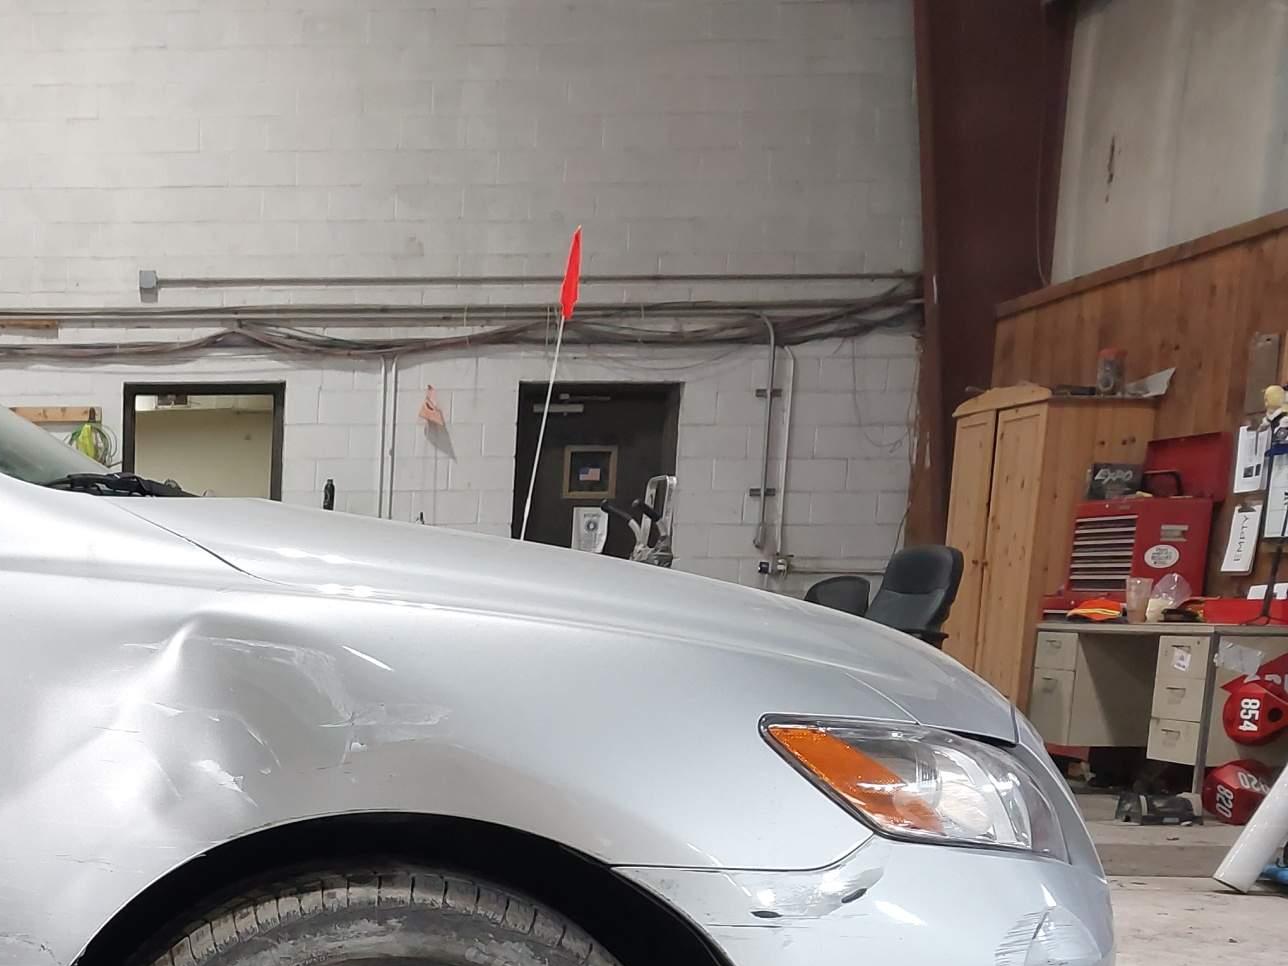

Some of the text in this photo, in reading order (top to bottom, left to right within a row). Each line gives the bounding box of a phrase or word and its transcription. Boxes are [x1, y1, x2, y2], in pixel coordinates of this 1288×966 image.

[1233, 514, 1249, 561] EMPTY
[1238, 698, 1261, 732] 854
[1216, 784, 1234, 818] 820
